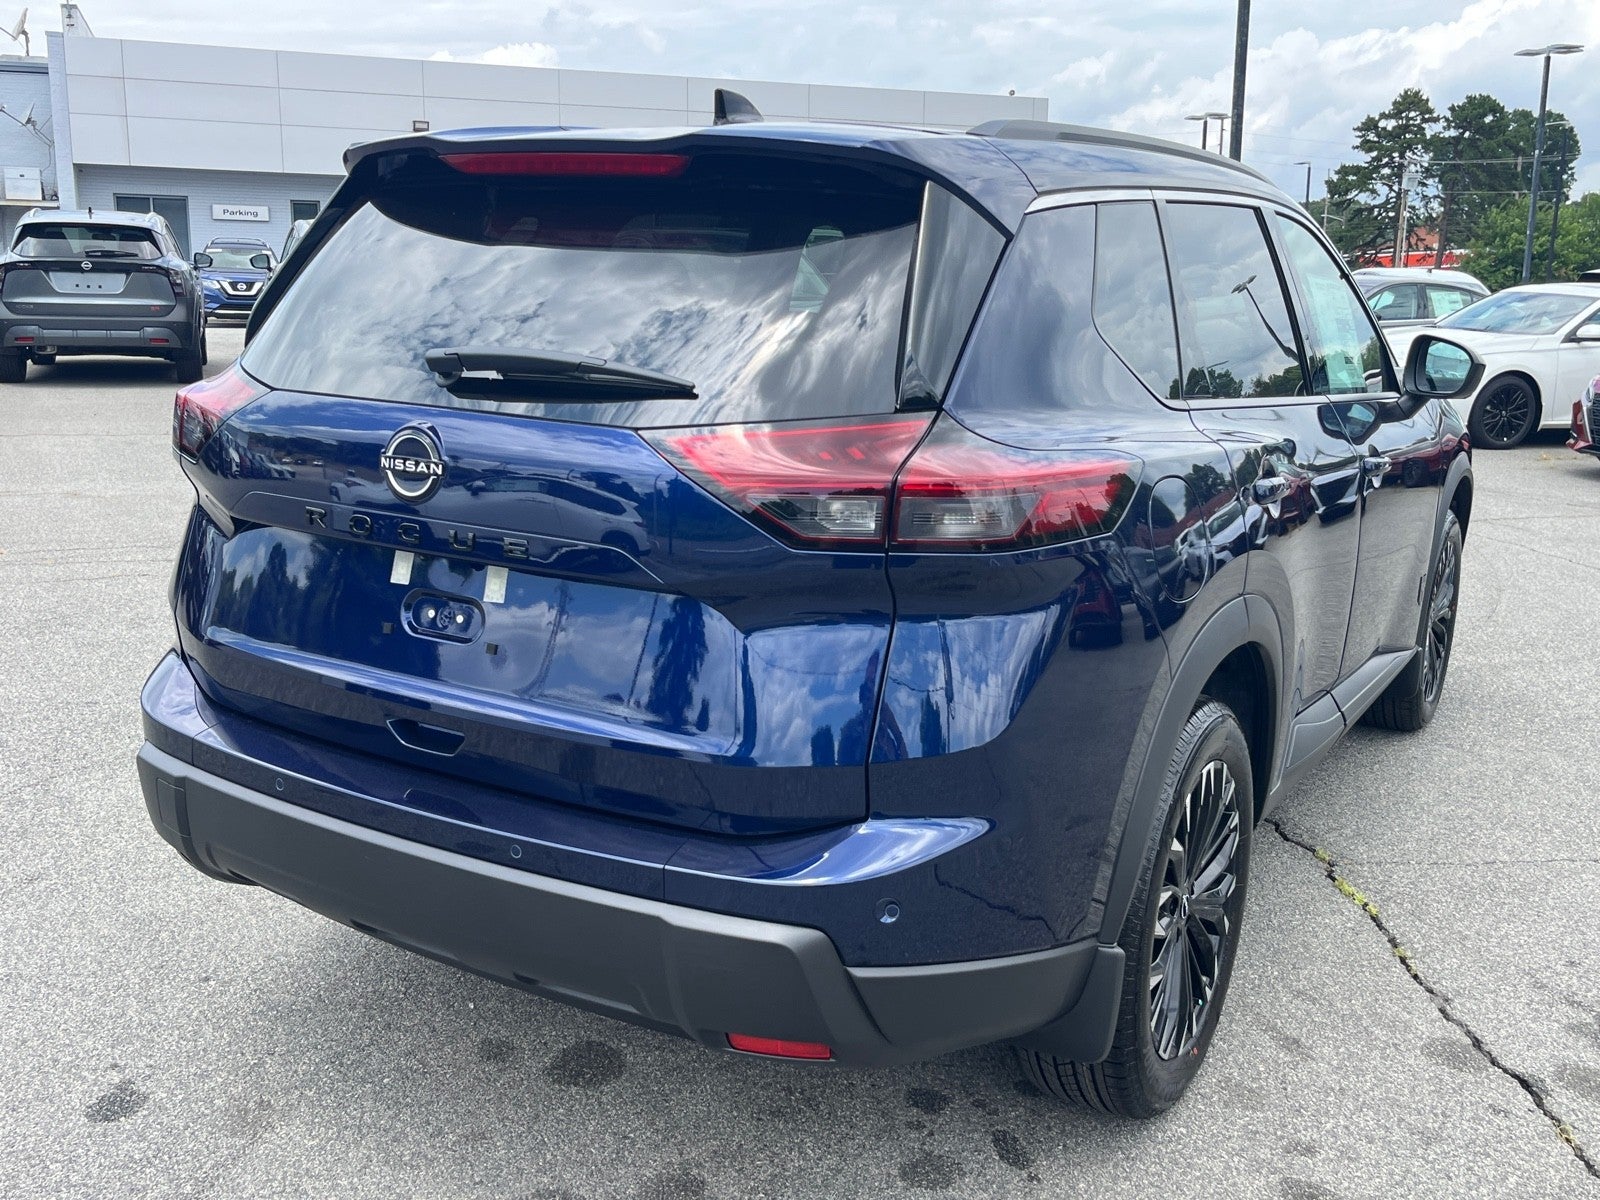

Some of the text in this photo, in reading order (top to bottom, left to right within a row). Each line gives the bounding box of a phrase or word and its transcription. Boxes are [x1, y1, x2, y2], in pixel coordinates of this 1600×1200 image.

[222, 208, 259, 218] Parking
[380, 457, 442, 475] NISSAN
[305, 506, 529, 558] ROGUE
